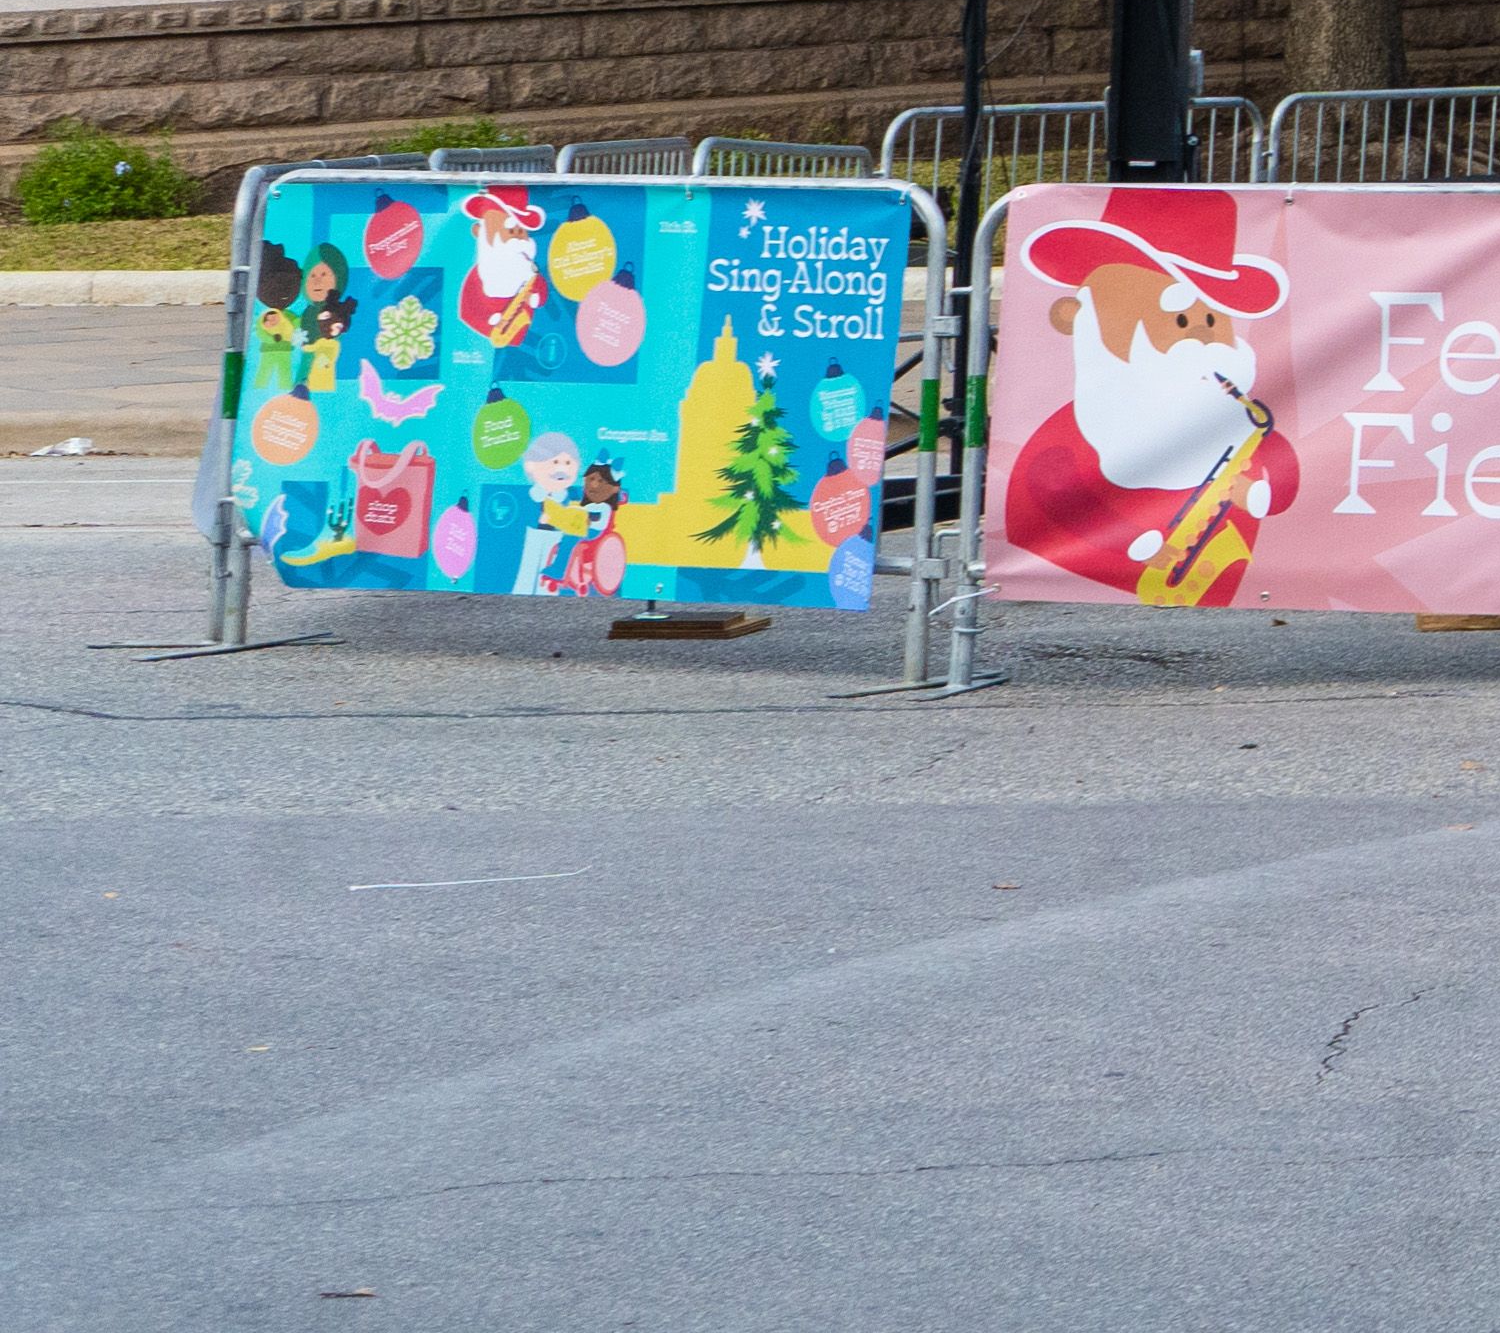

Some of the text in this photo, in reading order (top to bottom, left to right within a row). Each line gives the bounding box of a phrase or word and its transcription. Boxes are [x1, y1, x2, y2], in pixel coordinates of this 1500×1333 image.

[760, 226, 890, 270] Holiday
[707, 258, 887, 305] Sing-Along
[758, 304, 884, 340] & Stroll
